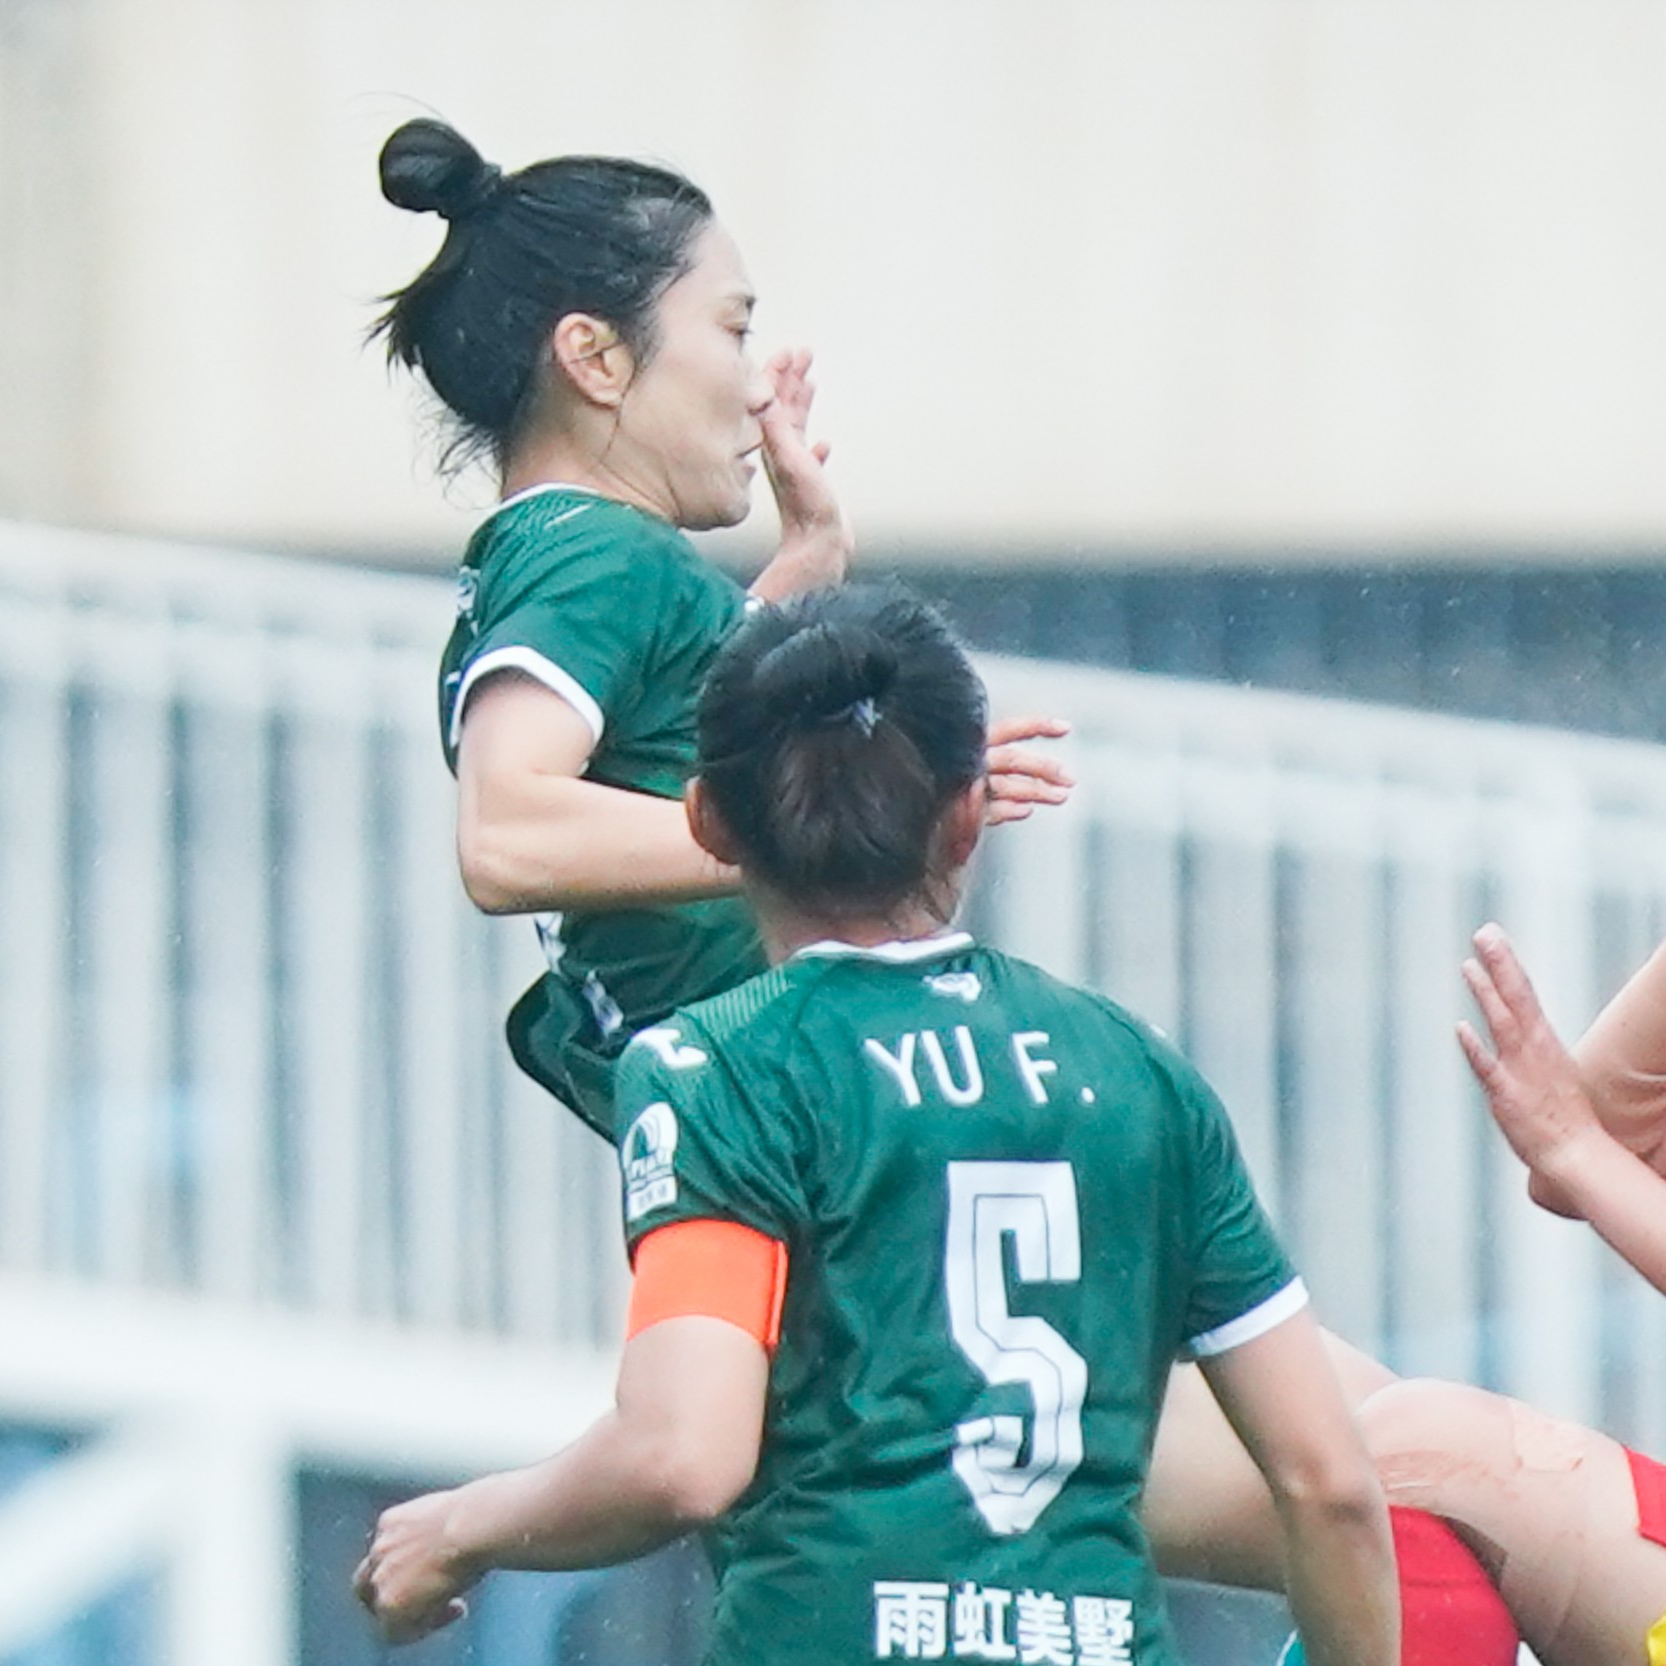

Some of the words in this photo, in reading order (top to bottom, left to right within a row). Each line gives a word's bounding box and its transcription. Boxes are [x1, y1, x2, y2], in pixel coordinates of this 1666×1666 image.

[864, 1025, 984, 1107] YU
[1010, 1031, 1096, 1104] F.
[945, 1160, 1088, 1536] 5
